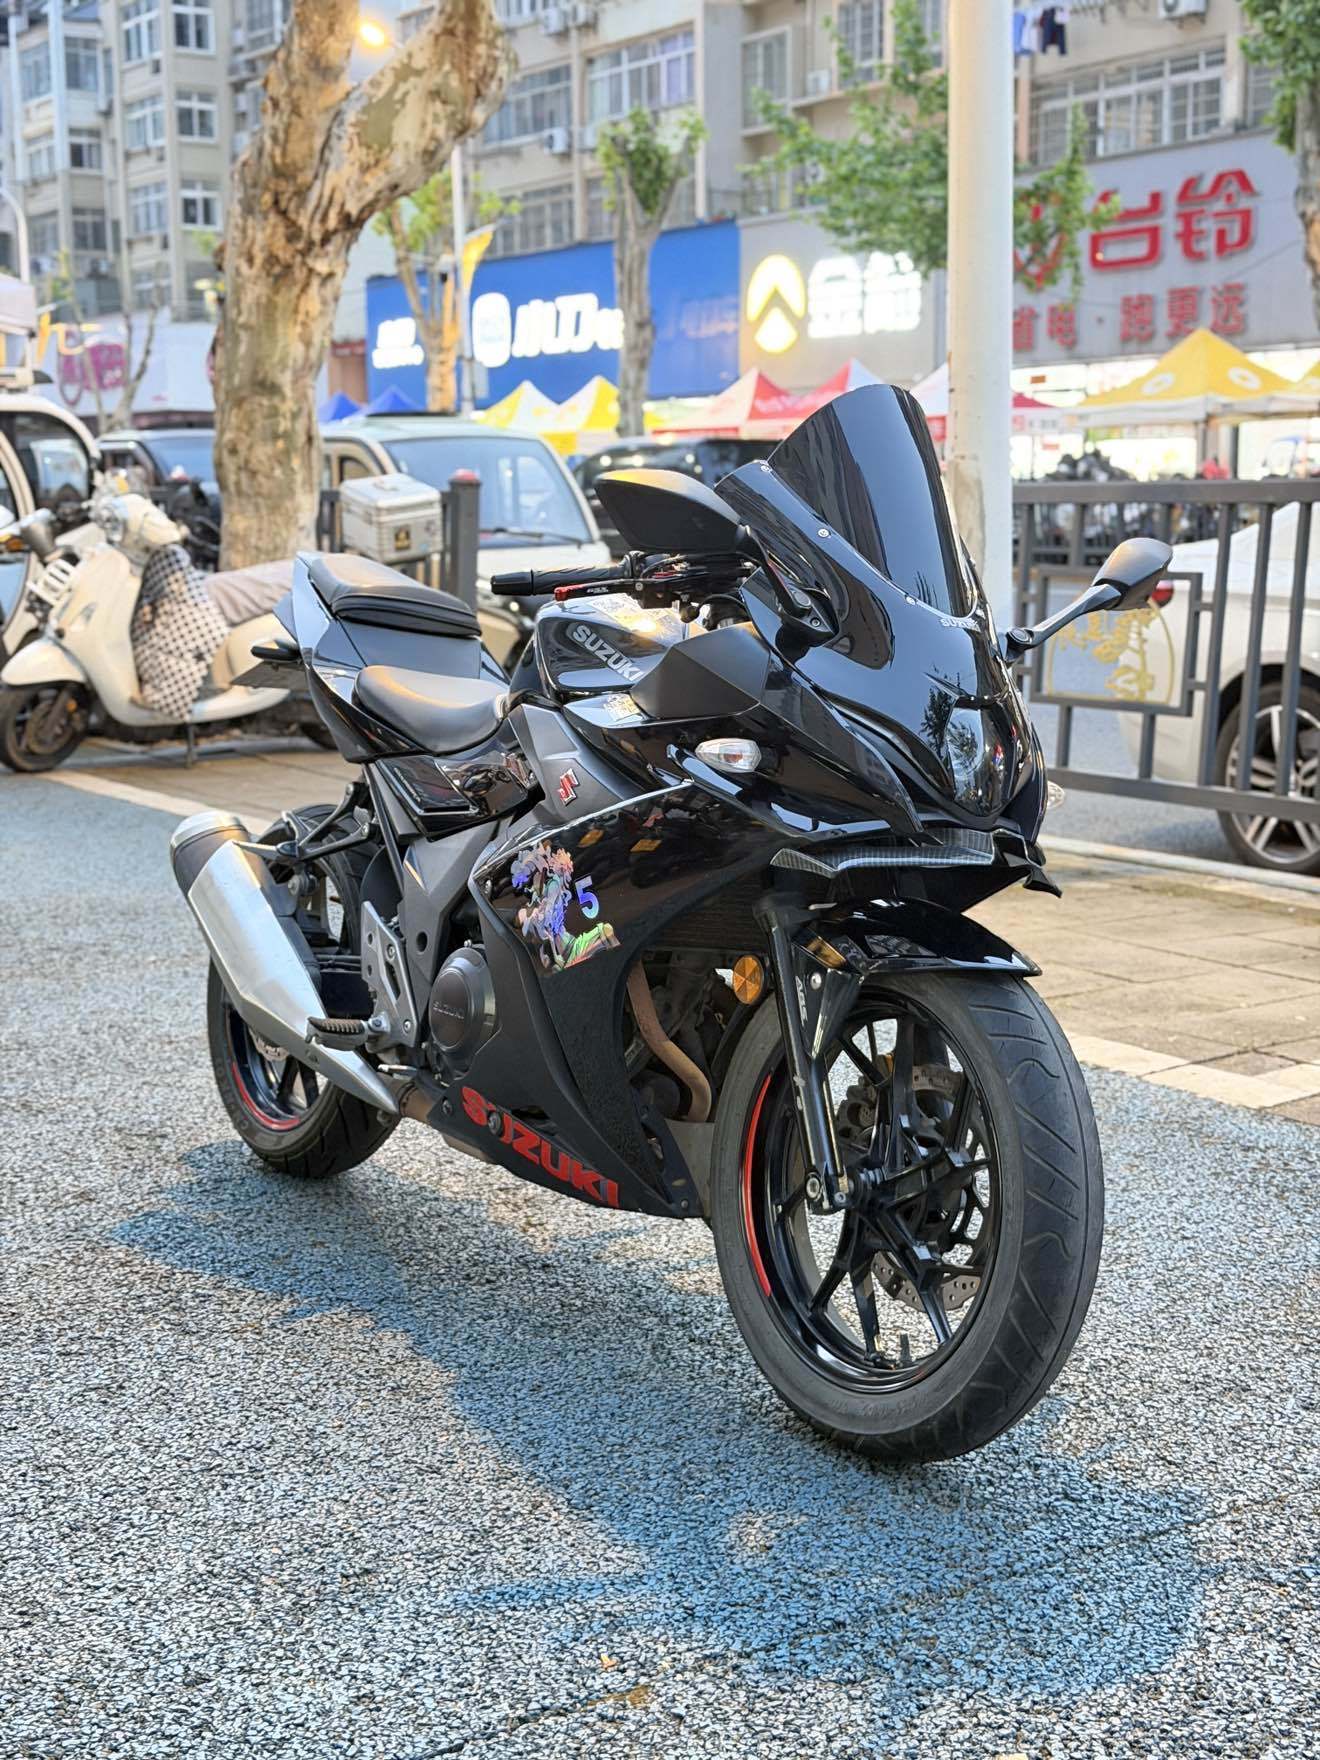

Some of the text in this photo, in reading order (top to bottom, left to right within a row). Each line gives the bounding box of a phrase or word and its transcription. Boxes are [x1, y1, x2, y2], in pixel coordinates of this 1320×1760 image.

[1088, 167, 1258, 270] 台铃
[572, 624, 645, 682] SUZUKI
[574, 874, 600, 919] 5
[461, 1086, 620, 1209] SUZUKI
